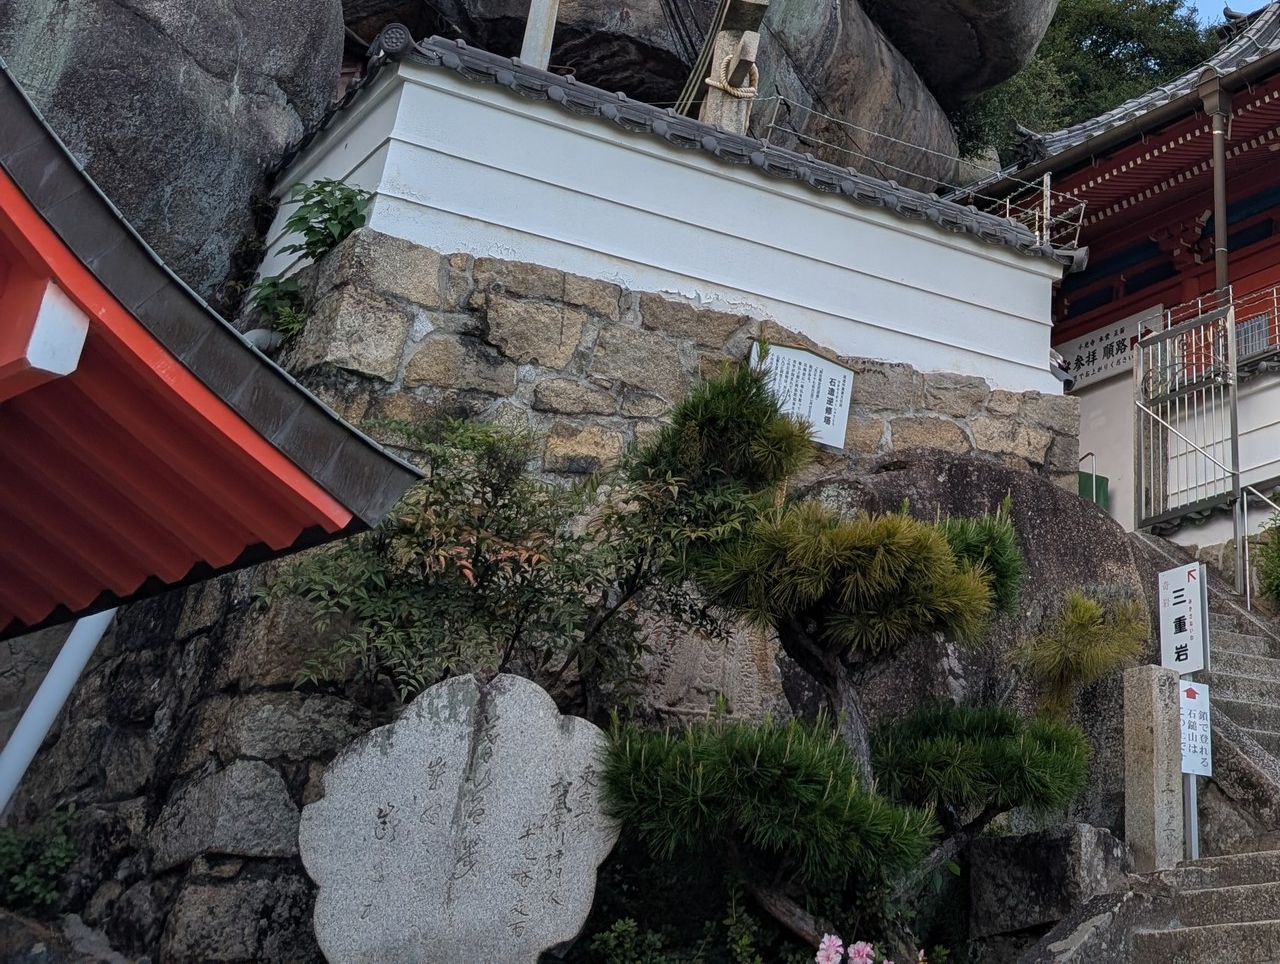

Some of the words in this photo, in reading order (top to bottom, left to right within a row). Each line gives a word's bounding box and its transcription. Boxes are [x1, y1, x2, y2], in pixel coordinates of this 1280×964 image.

[1102, 337, 1128, 360] 順路
[823, 377, 837, 426] 石造逆修塔
[1172, 587, 1189, 662] 三重岩
[1187, 708, 1198, 754] 石鎚山は
[1198, 710, 1209, 768] 鎖で登れる
